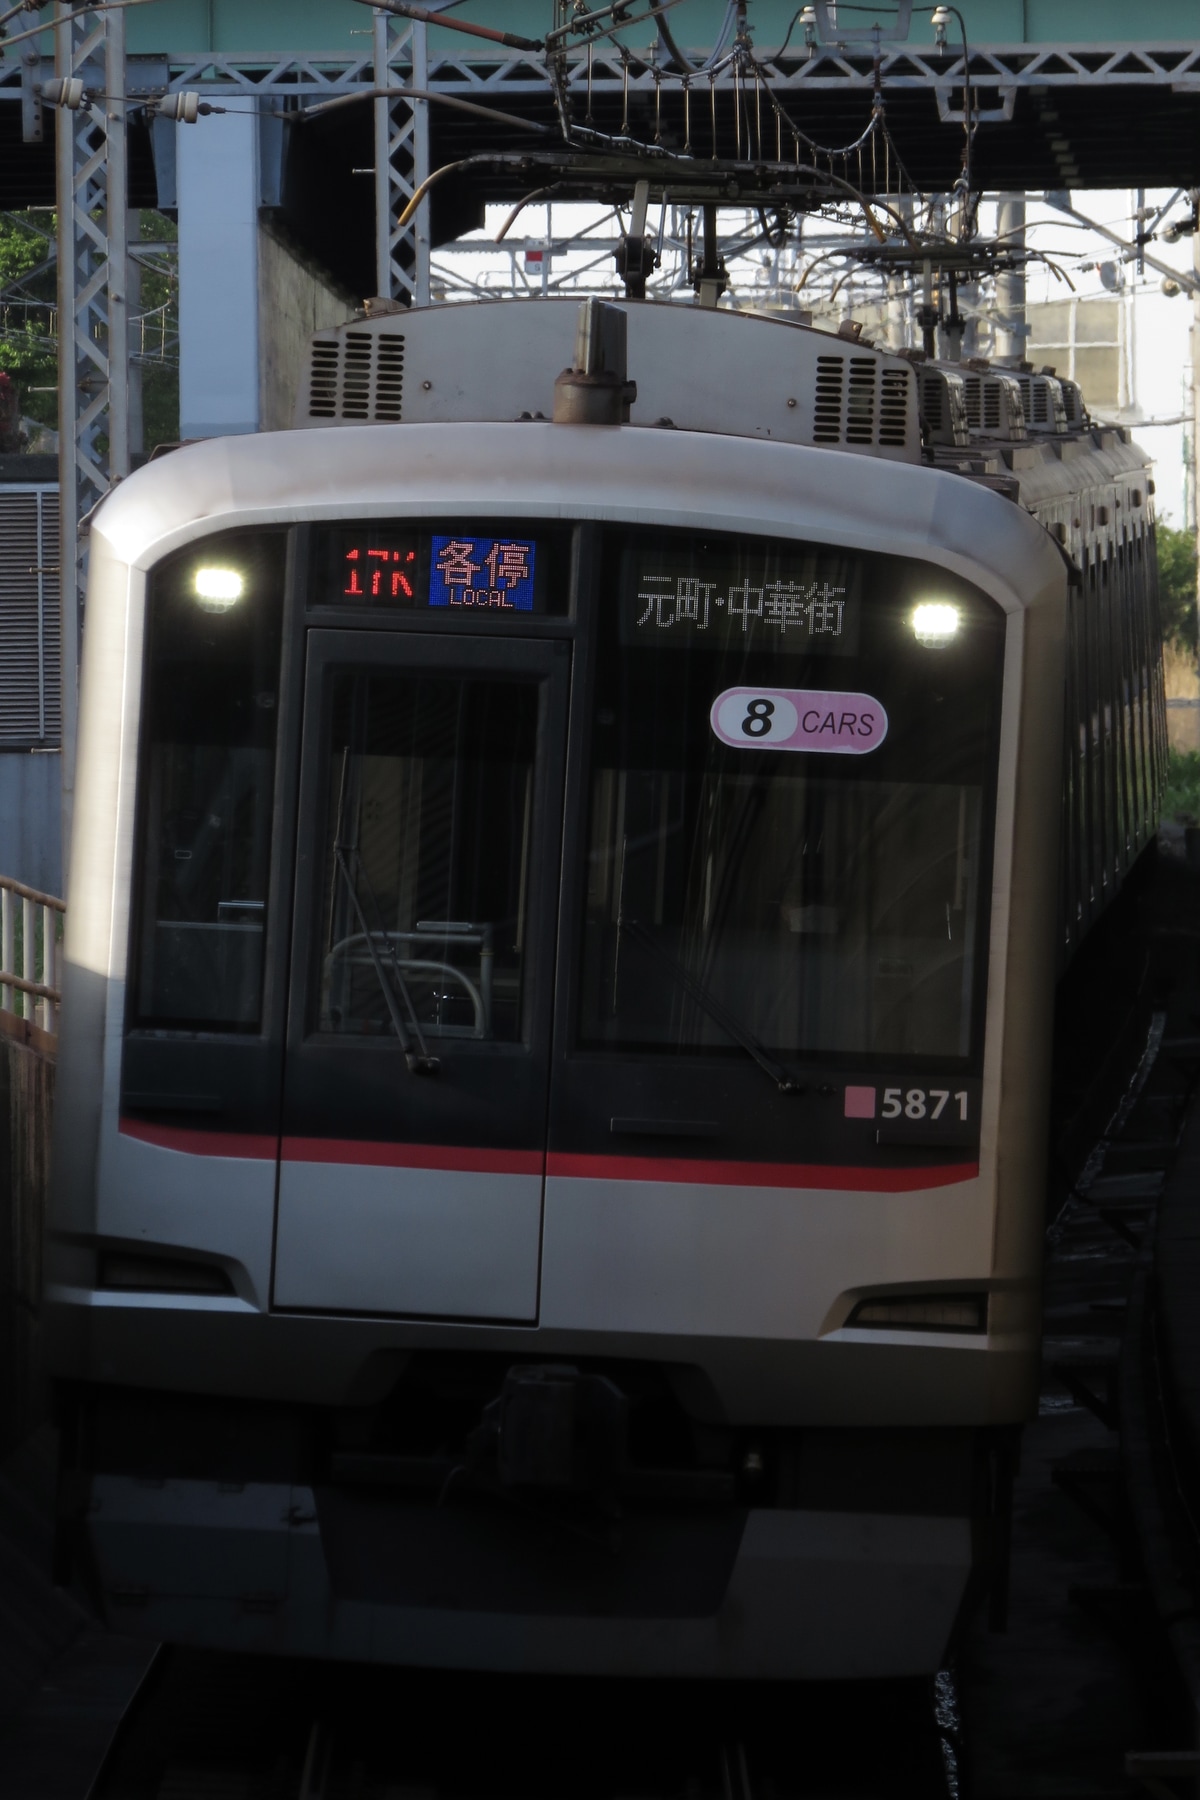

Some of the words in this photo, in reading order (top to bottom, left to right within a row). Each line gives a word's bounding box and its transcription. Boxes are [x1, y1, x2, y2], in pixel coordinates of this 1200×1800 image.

[436, 540, 530, 588] 各停
[450, 588, 514, 607] LOCAL
[637, 576, 846, 636] 元町・中華街
[741, 698, 775, 738] 8
[801, 710, 875, 737] CARS
[881, 1088, 968, 1121] 5871
